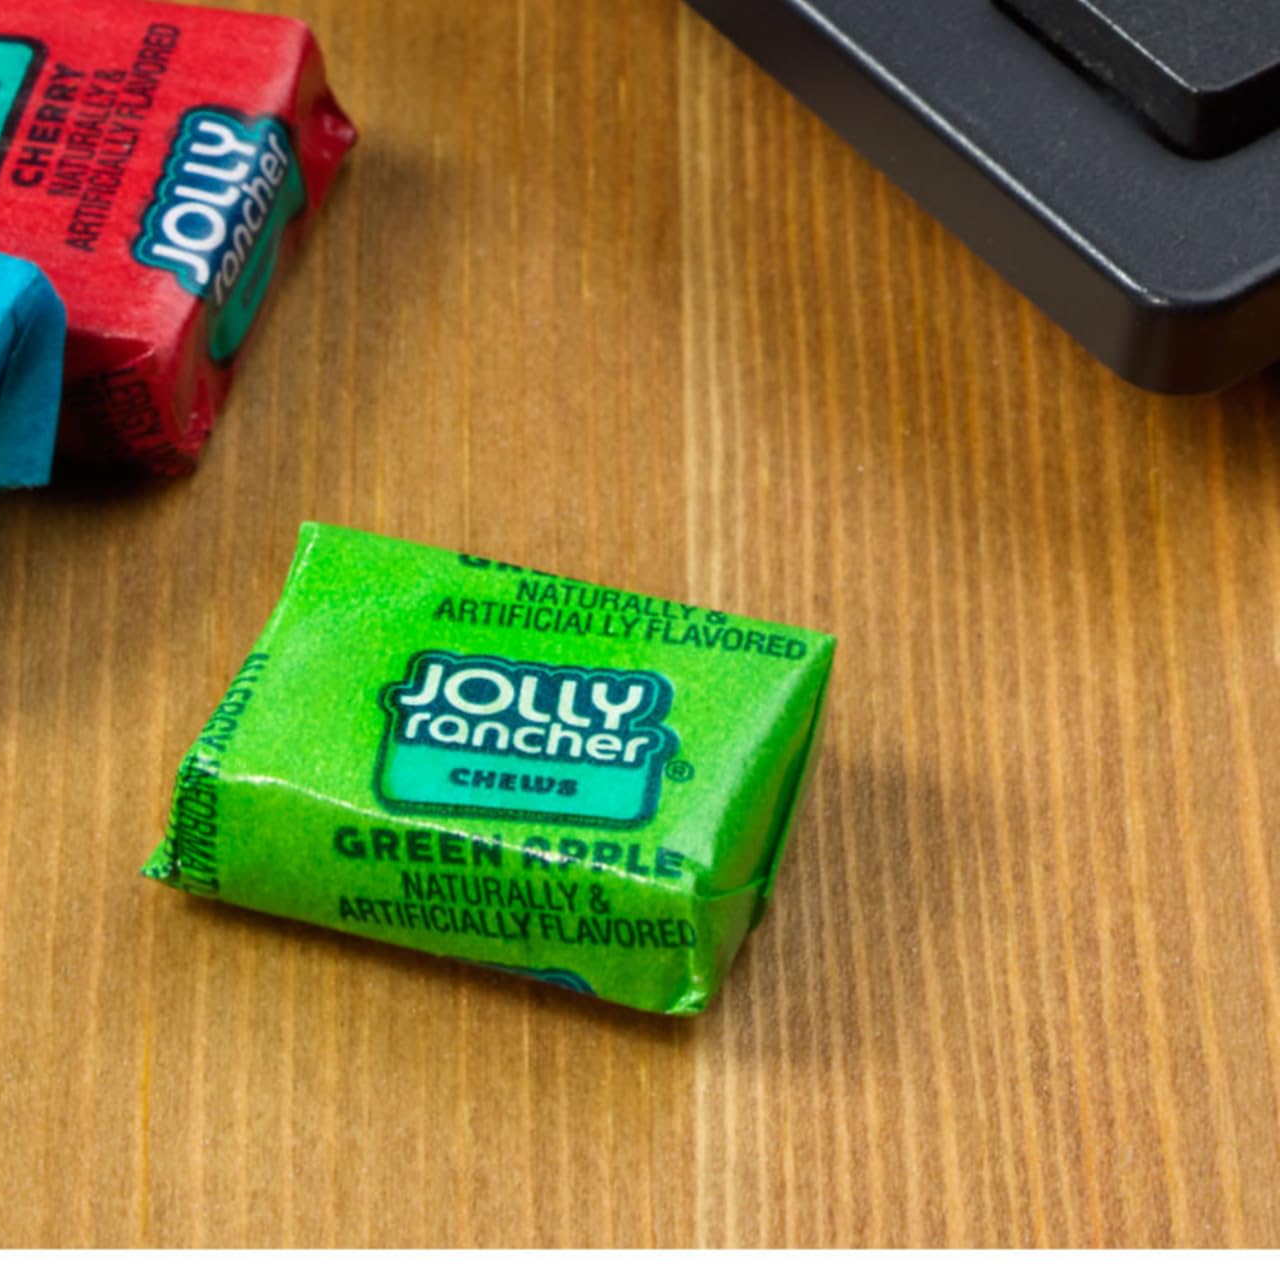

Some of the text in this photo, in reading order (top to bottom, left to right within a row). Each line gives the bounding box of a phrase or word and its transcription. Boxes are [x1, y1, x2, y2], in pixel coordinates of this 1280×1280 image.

[10, 63, 85, 187] CHERRY
[47, 83, 118, 198] NATURALLY
[64, 23, 182, 253] ARTIFICIALLY FLAVORED
[151, 120, 257, 285] JOLLY
[214, 132, 288, 305] rancher
[433, 596, 807, 661] ARTIFICIALLY FLAVORED
[516, 580, 700, 622] NATURALLY
[399, 663, 644, 730] JOLLY
[404, 711, 649, 763] rancher
[448, 767, 579, 797] CHEWS
[332, 826, 687, 879] GREEN APPLE
[338, 895, 696, 949] ARTIFICIALLY FLAVORED
[400, 871, 611, 915] NATURALLY &
